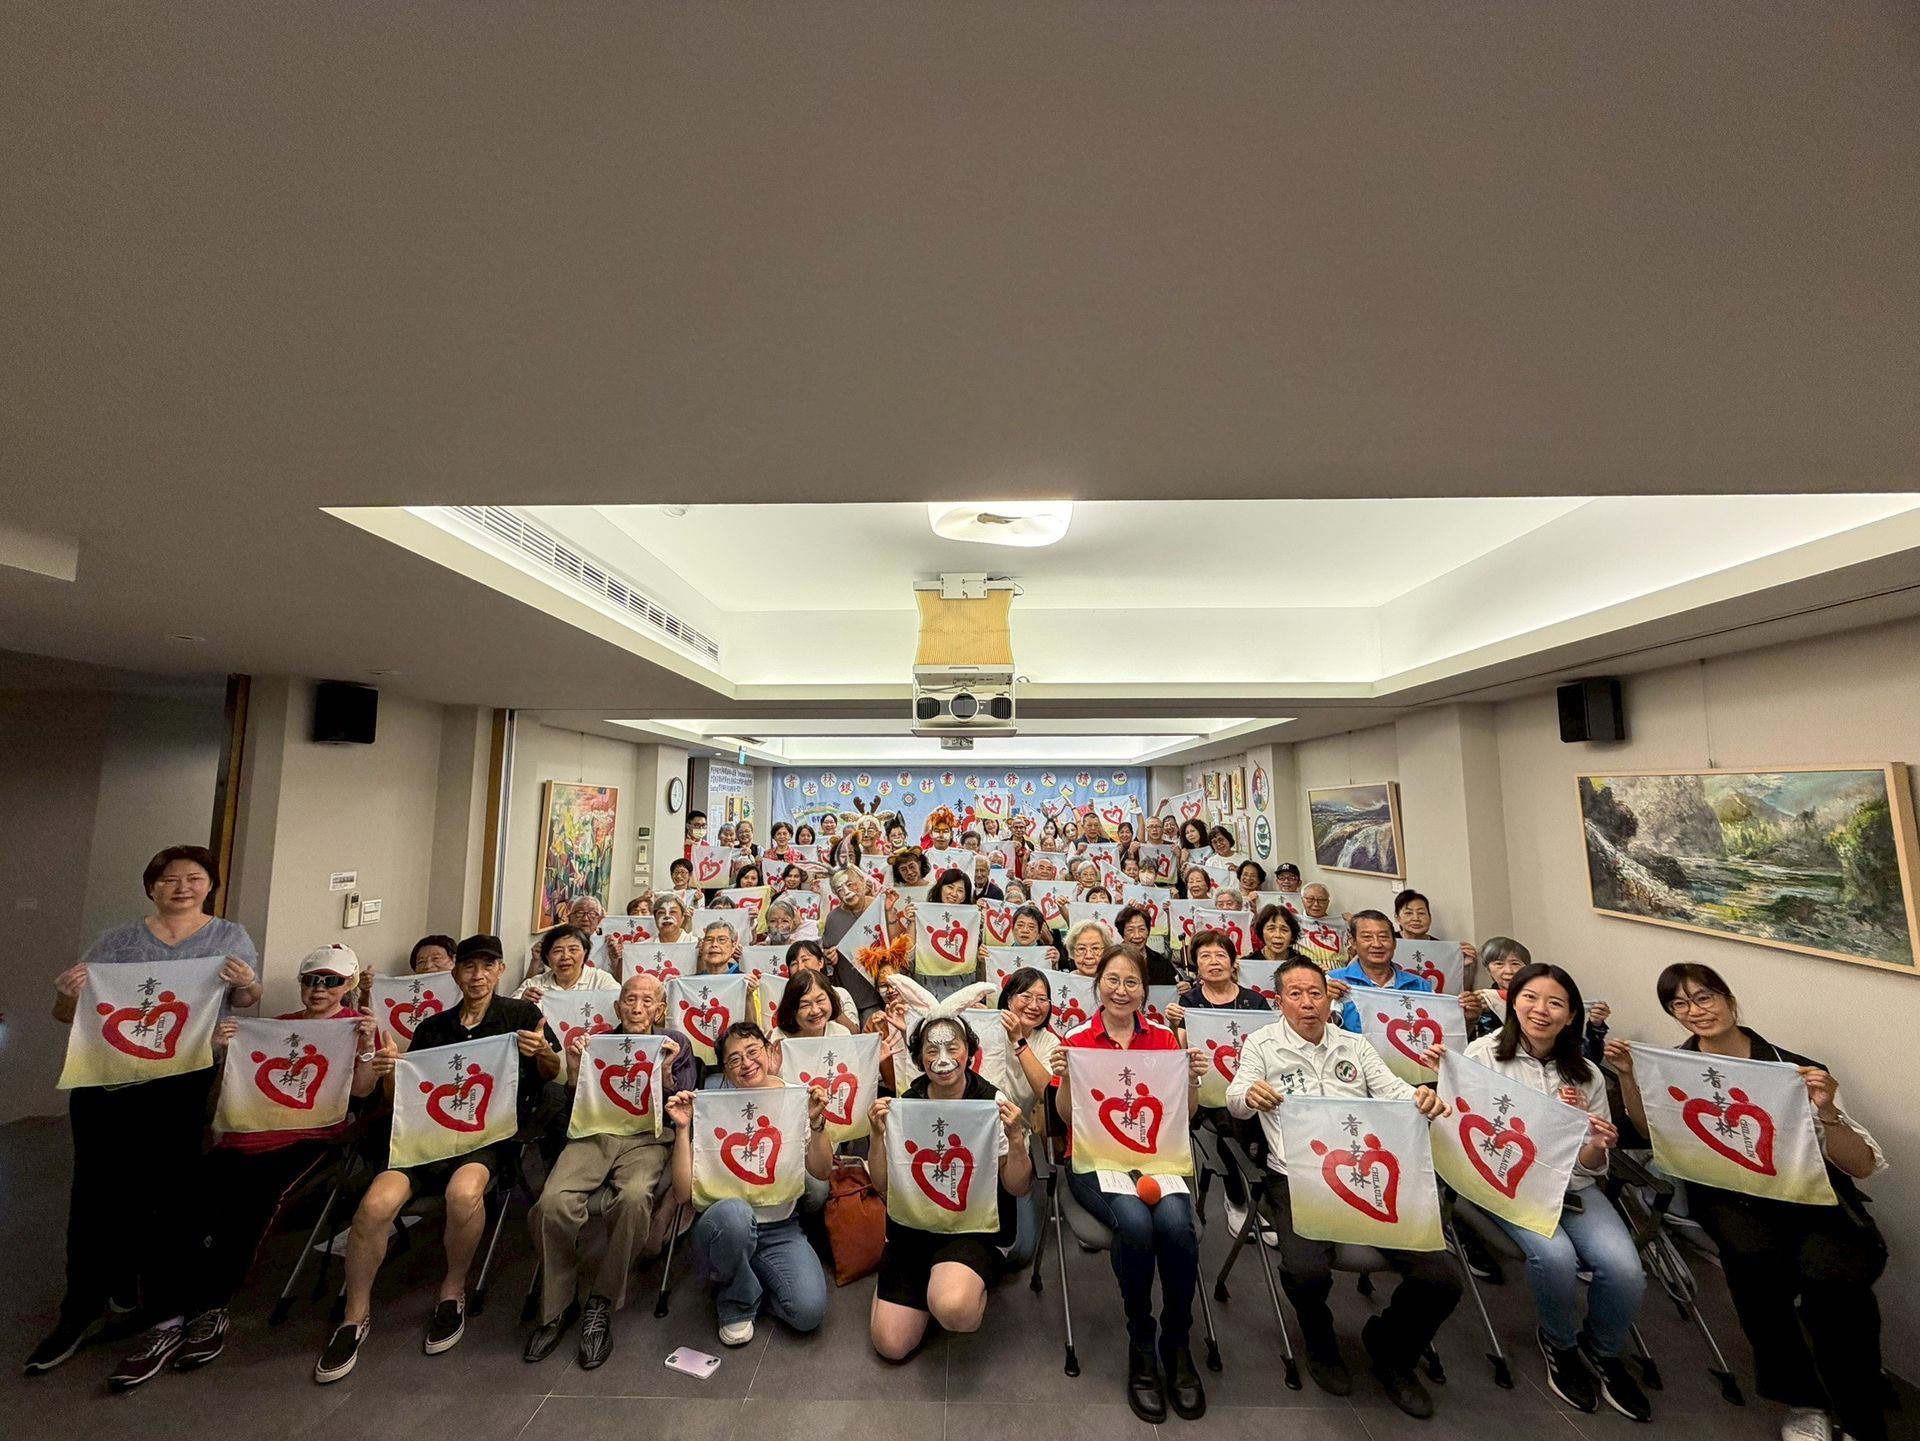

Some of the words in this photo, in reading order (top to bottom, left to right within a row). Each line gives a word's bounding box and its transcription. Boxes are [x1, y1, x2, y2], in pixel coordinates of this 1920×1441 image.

[130, 977, 162, 1037] 耆老林
[448, 1053, 469, 1111] 耆老林
[619, 1037, 635, 1092] 耆老林
[1297, 1069, 1307, 1094] 台中
[1118, 1066, 1138, 1130] 耆老林
[1479, 1094, 1516, 1158] 耆老林
[1701, 1067, 1741, 1139] 耆老林
[741, 1101, 758, 1162] 耆老林
[932, 1117, 949, 1183] 耆老林
[1340, 1113, 1371, 1189] 耆老林
